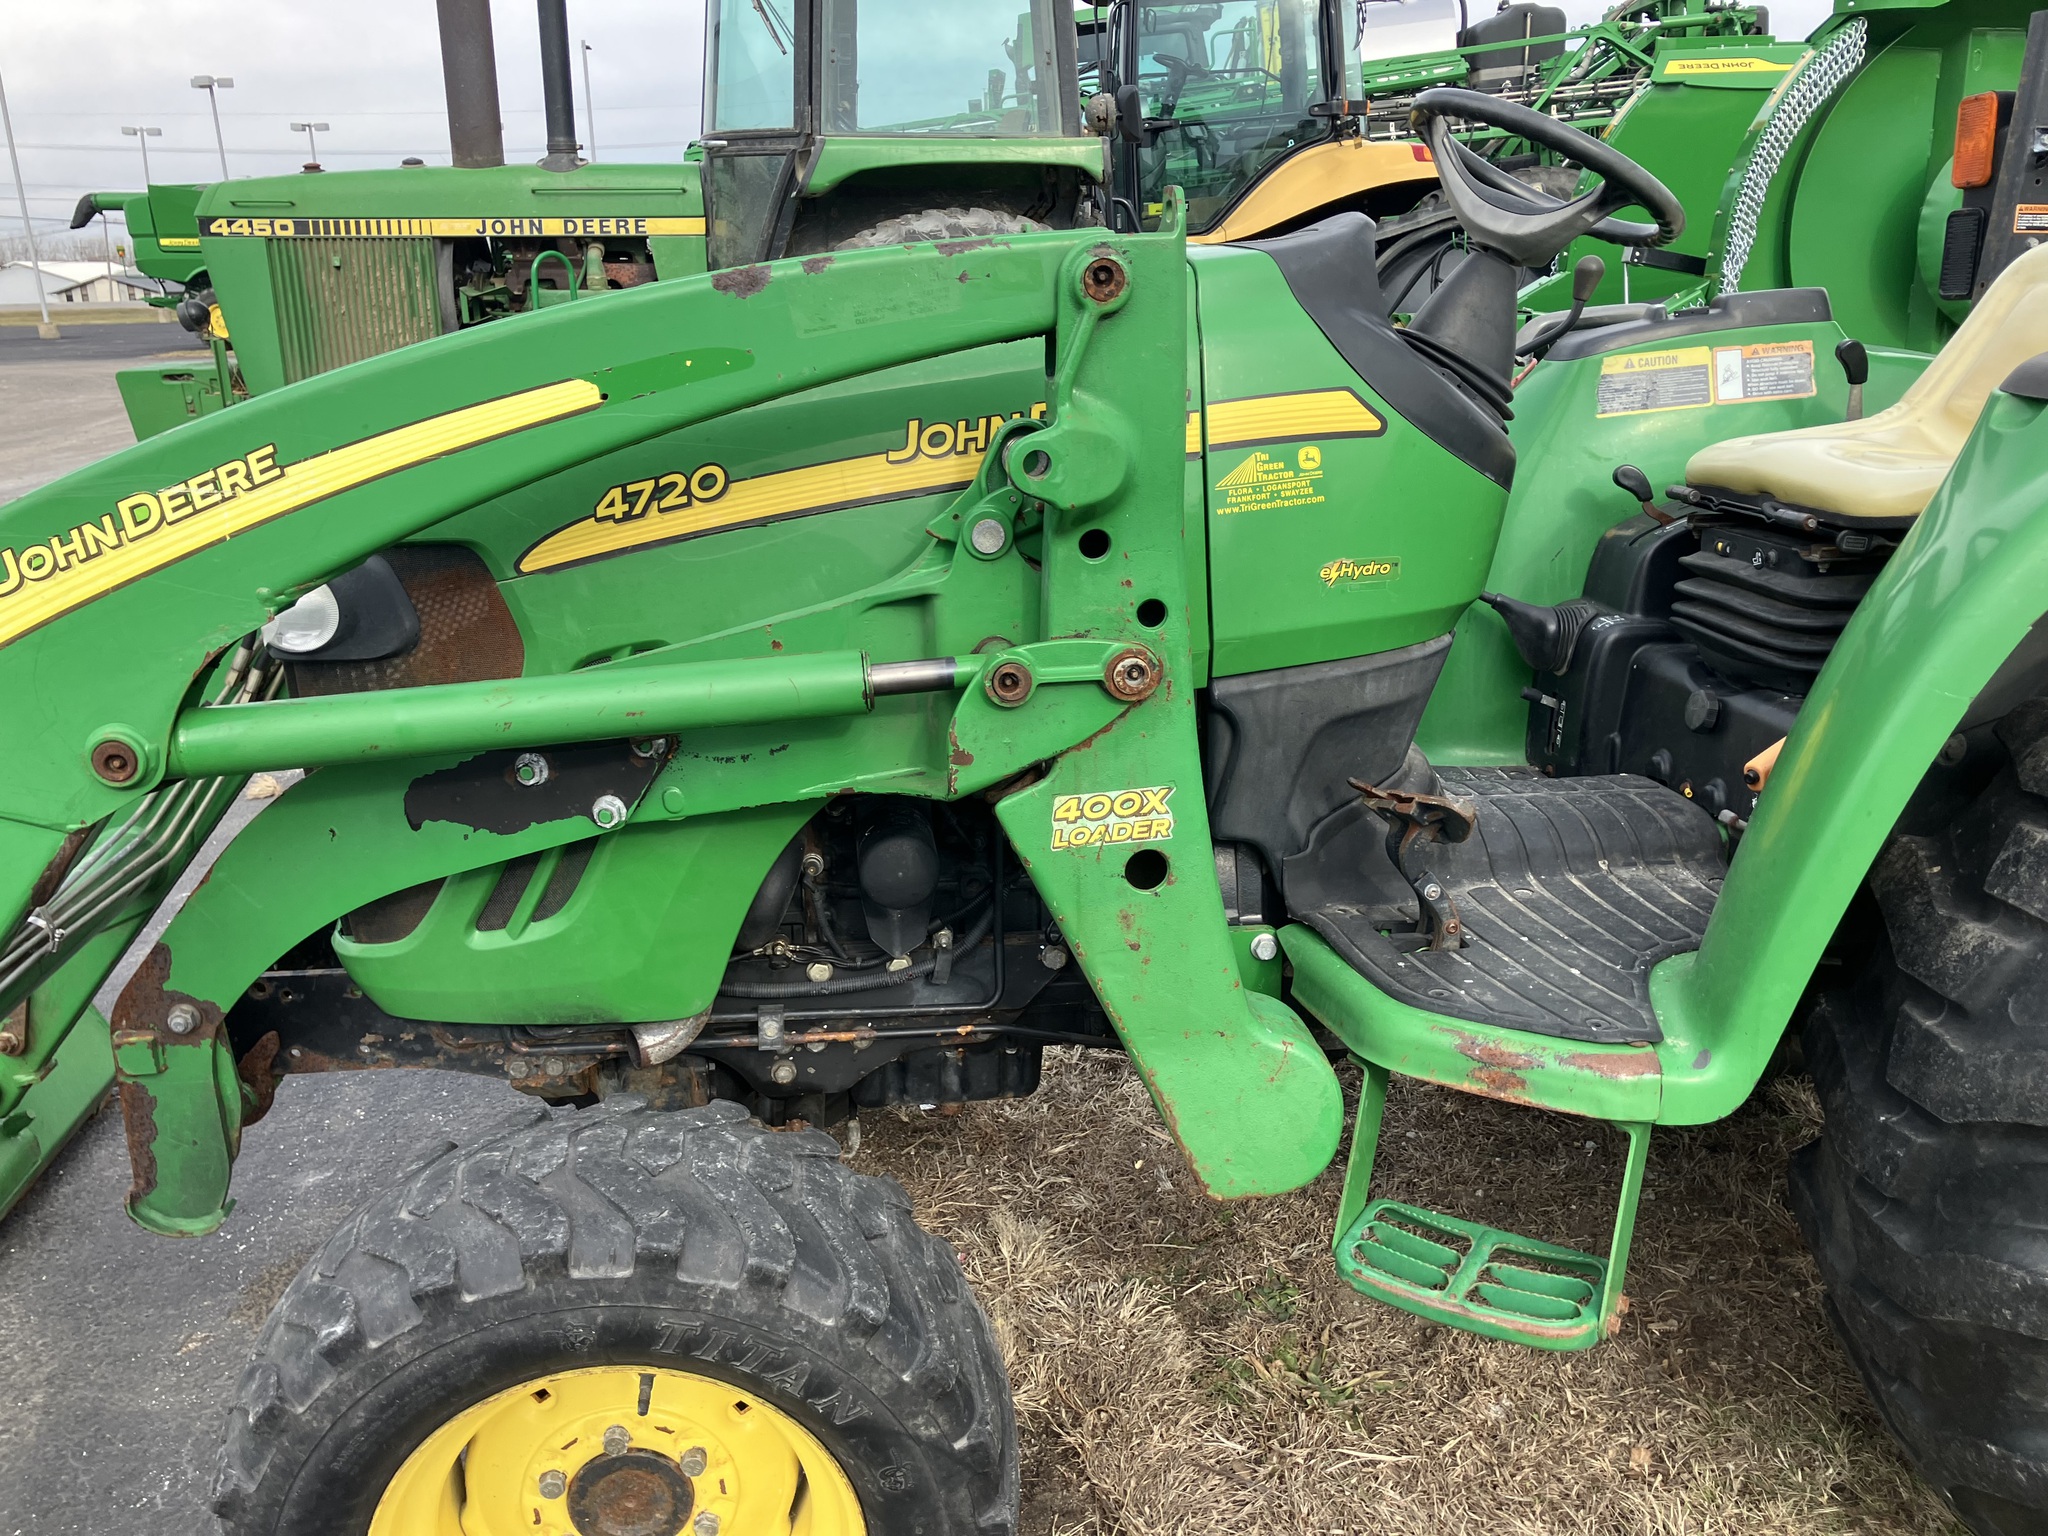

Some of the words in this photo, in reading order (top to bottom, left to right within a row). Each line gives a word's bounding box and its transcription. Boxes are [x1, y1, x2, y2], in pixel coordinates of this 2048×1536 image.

[1678, 62, 1720, 70] DEERE
[1722, 61, 1755, 69] JOHN
[209, 218, 295, 236] 4450
[475, 218, 544, 235] JOHN
[563, 218, 648, 235] DEERE
[1761, 344, 1805, 355] WARNING
[1638, 355, 1678, 368] CAUTION
[1255, 451, 1269, 461] TRI
[1256, 462, 1285, 471] GREEN
[1257, 470, 1294, 481] TRACTOR
[594, 462, 729, 523] 4720
[1226, 492, 1271, 504] FRANKFORT
[1280, 486, 1314, 497] SWAYZEE
[1228, 487, 1253, 496] FLORA
[1262, 480, 1311, 492] LOGANSPORT
[1216, 494, 1325, 515] www.TriGreenTractor.com
[0, 512, 122, 598] JOHN
[116, 442, 286, 542] DEERE
[1053, 786, 1174, 824] 400X
[1051, 818, 1172, 849] LOADER
[650, 1316, 875, 1426] TITAN
